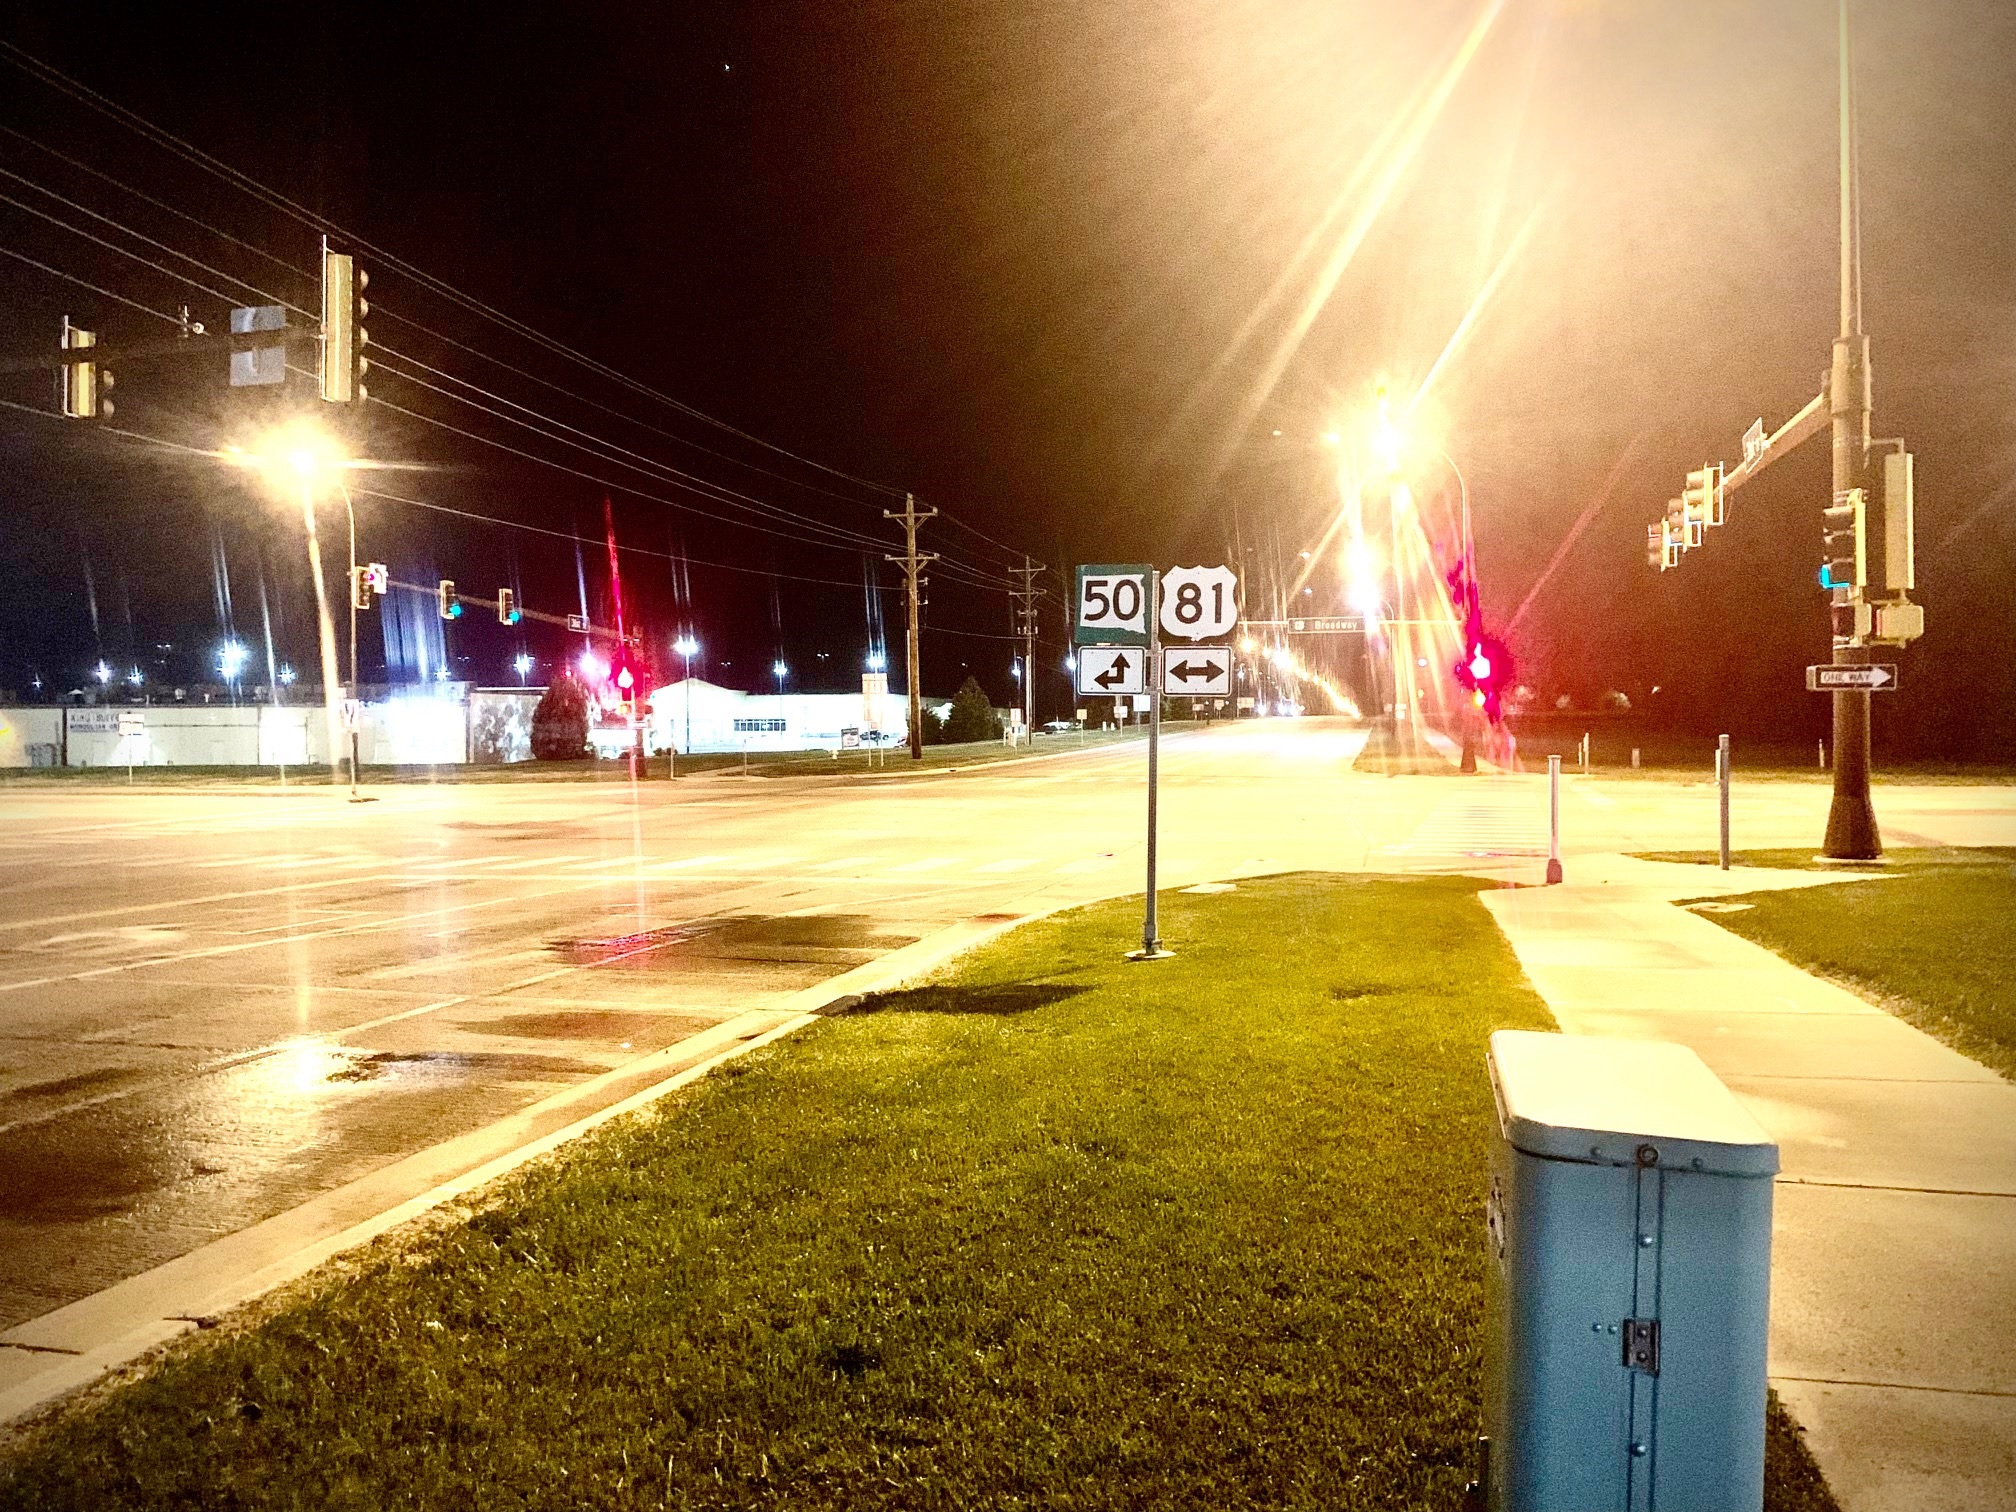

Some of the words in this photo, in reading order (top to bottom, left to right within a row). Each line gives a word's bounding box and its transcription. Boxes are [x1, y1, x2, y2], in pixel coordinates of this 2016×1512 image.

[1084, 579, 1140, 621] 50
[1175, 582, 1222, 624] 81
[1314, 620, 1358, 631] Broadway
[1823, 672, 1845, 682] ONE
[1848, 672, 1870, 681] WAY
